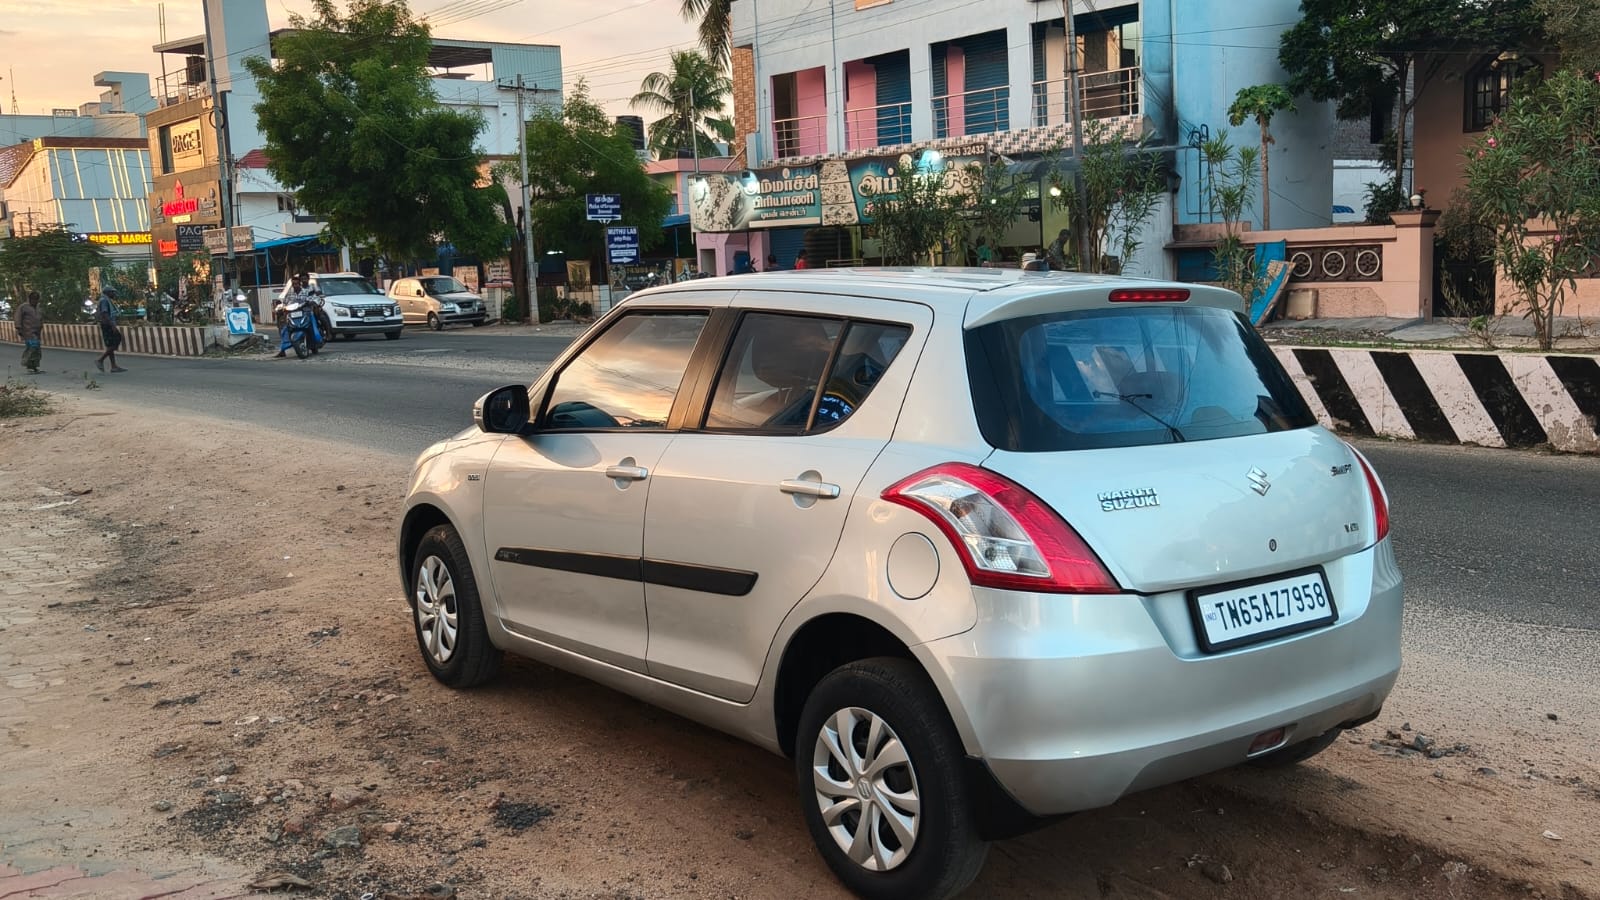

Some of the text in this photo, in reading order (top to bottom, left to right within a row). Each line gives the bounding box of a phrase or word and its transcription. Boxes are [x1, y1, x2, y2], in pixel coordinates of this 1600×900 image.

[962, 145, 985, 156] 32432
[89, 234, 120, 244] SUPER
[1097, 488, 1157, 501] MARUTI
[1101, 496, 1160, 511] SUZUKI
[1215, 582, 1326, 630] TN65AZ7958
